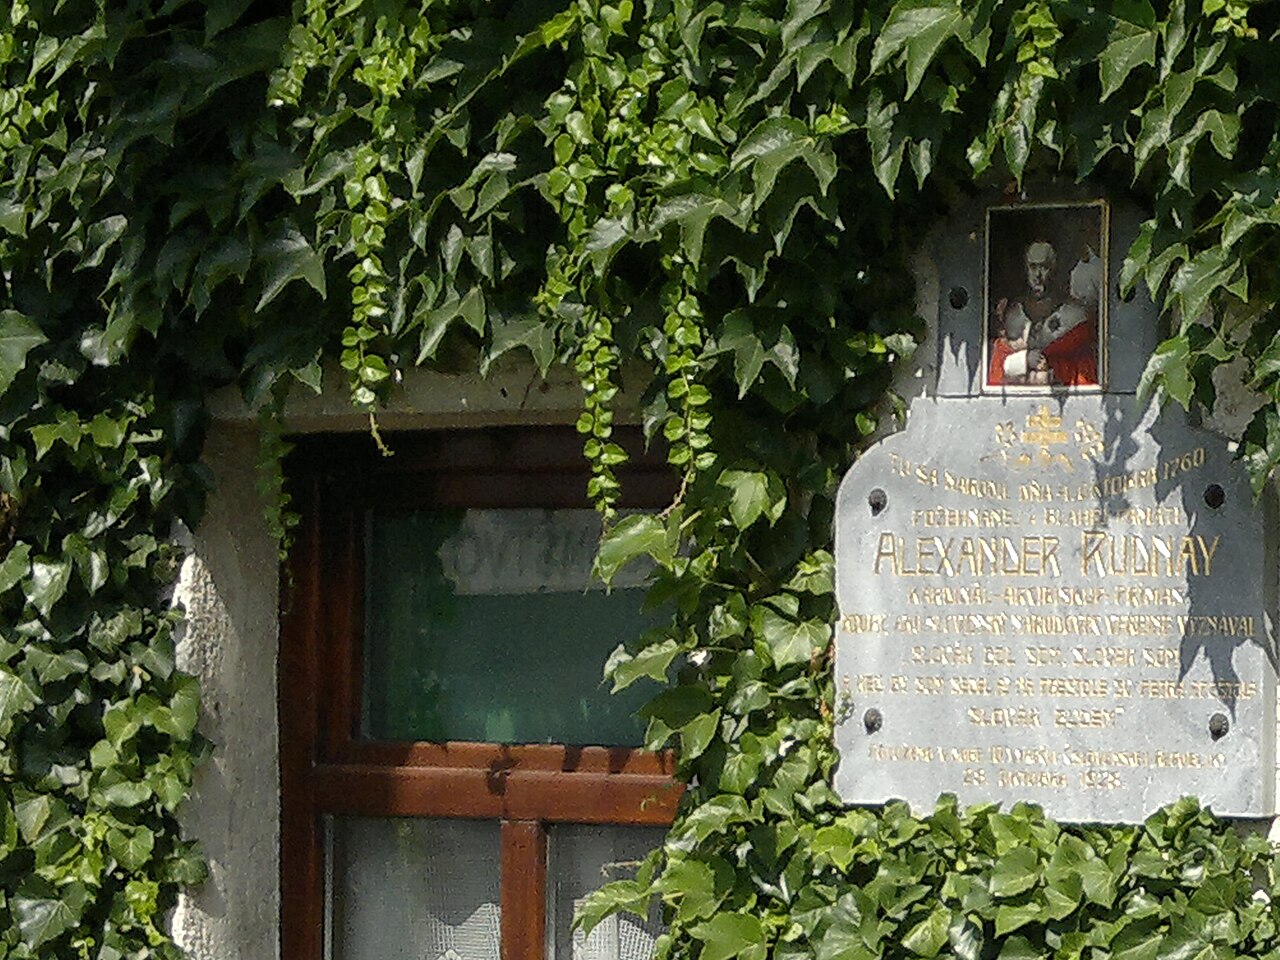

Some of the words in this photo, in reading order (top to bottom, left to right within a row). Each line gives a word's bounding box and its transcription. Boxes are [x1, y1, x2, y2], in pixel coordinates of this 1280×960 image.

[1162, 447, 1206, 480] 1760
[874, 531, 1062, 577] ALEXANDER
[1080, 530, 1221, 578] RUDNAY
